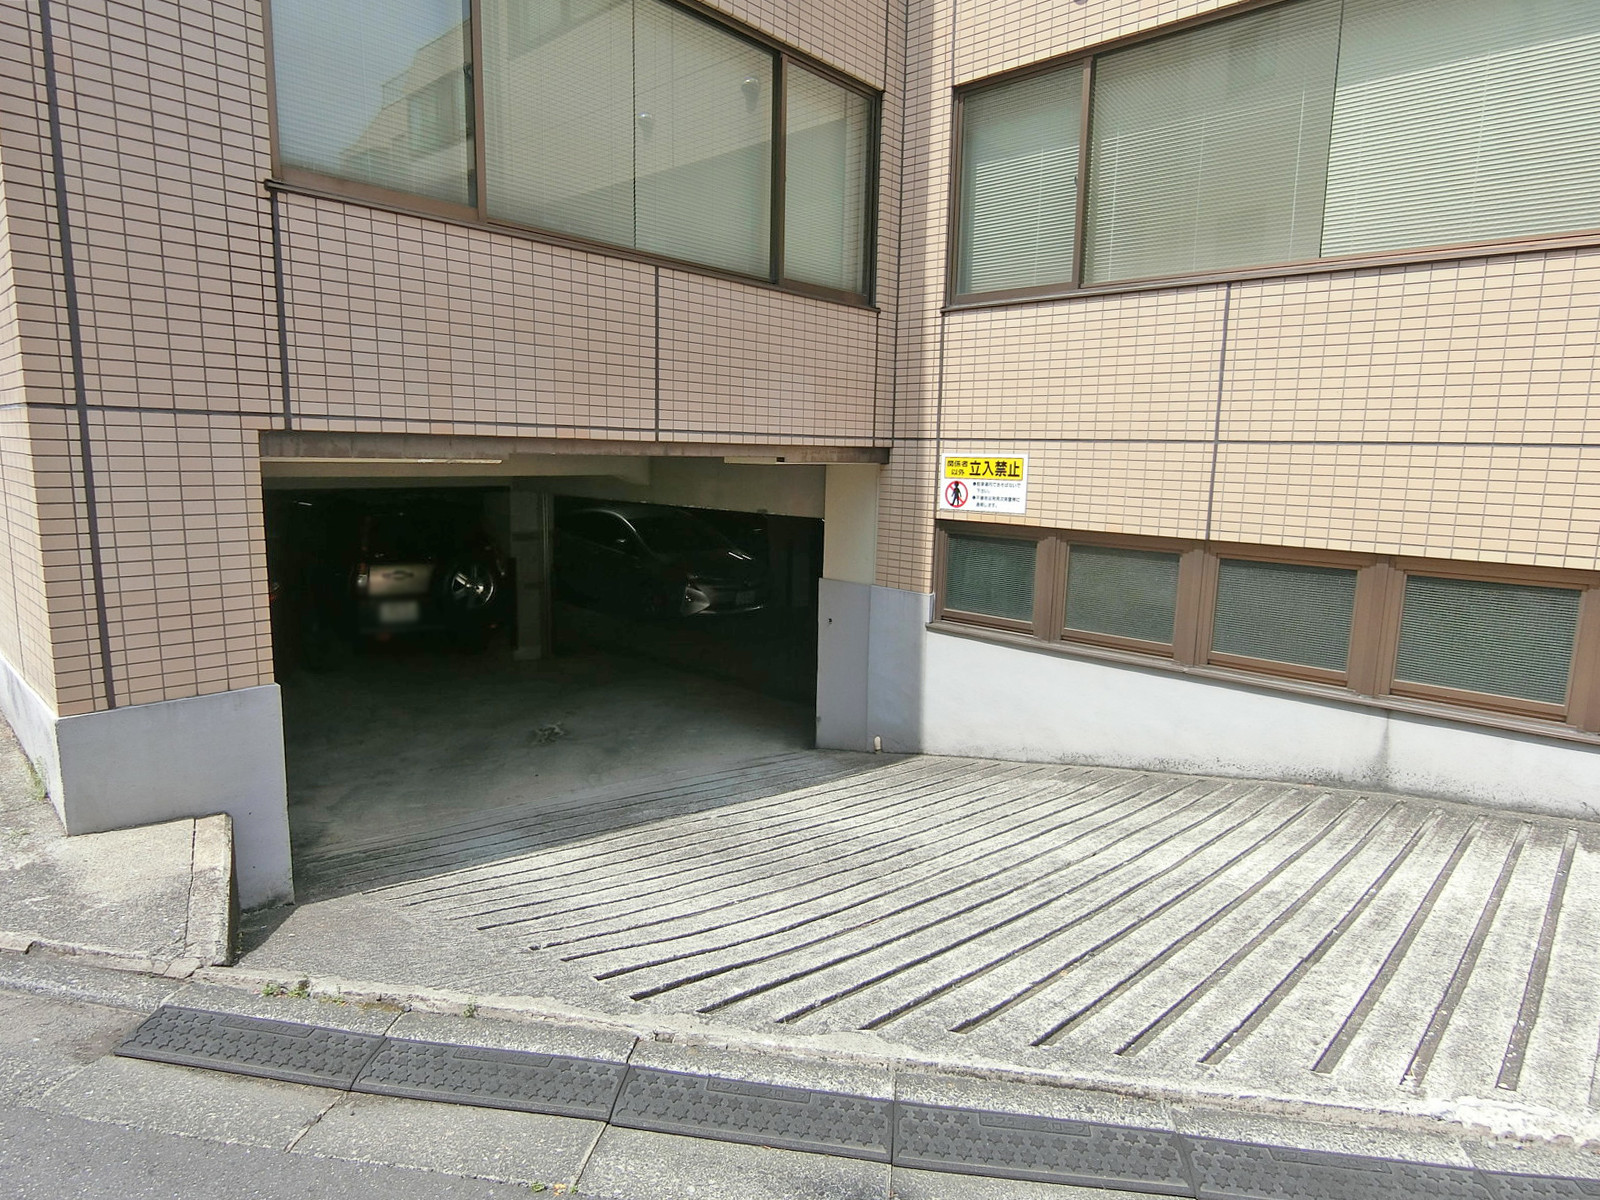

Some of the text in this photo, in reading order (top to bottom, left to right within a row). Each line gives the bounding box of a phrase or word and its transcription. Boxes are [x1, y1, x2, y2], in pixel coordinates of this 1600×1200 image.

[947, 460, 968, 468] 関係者
[969, 460, 1020, 477] 立入禁止
